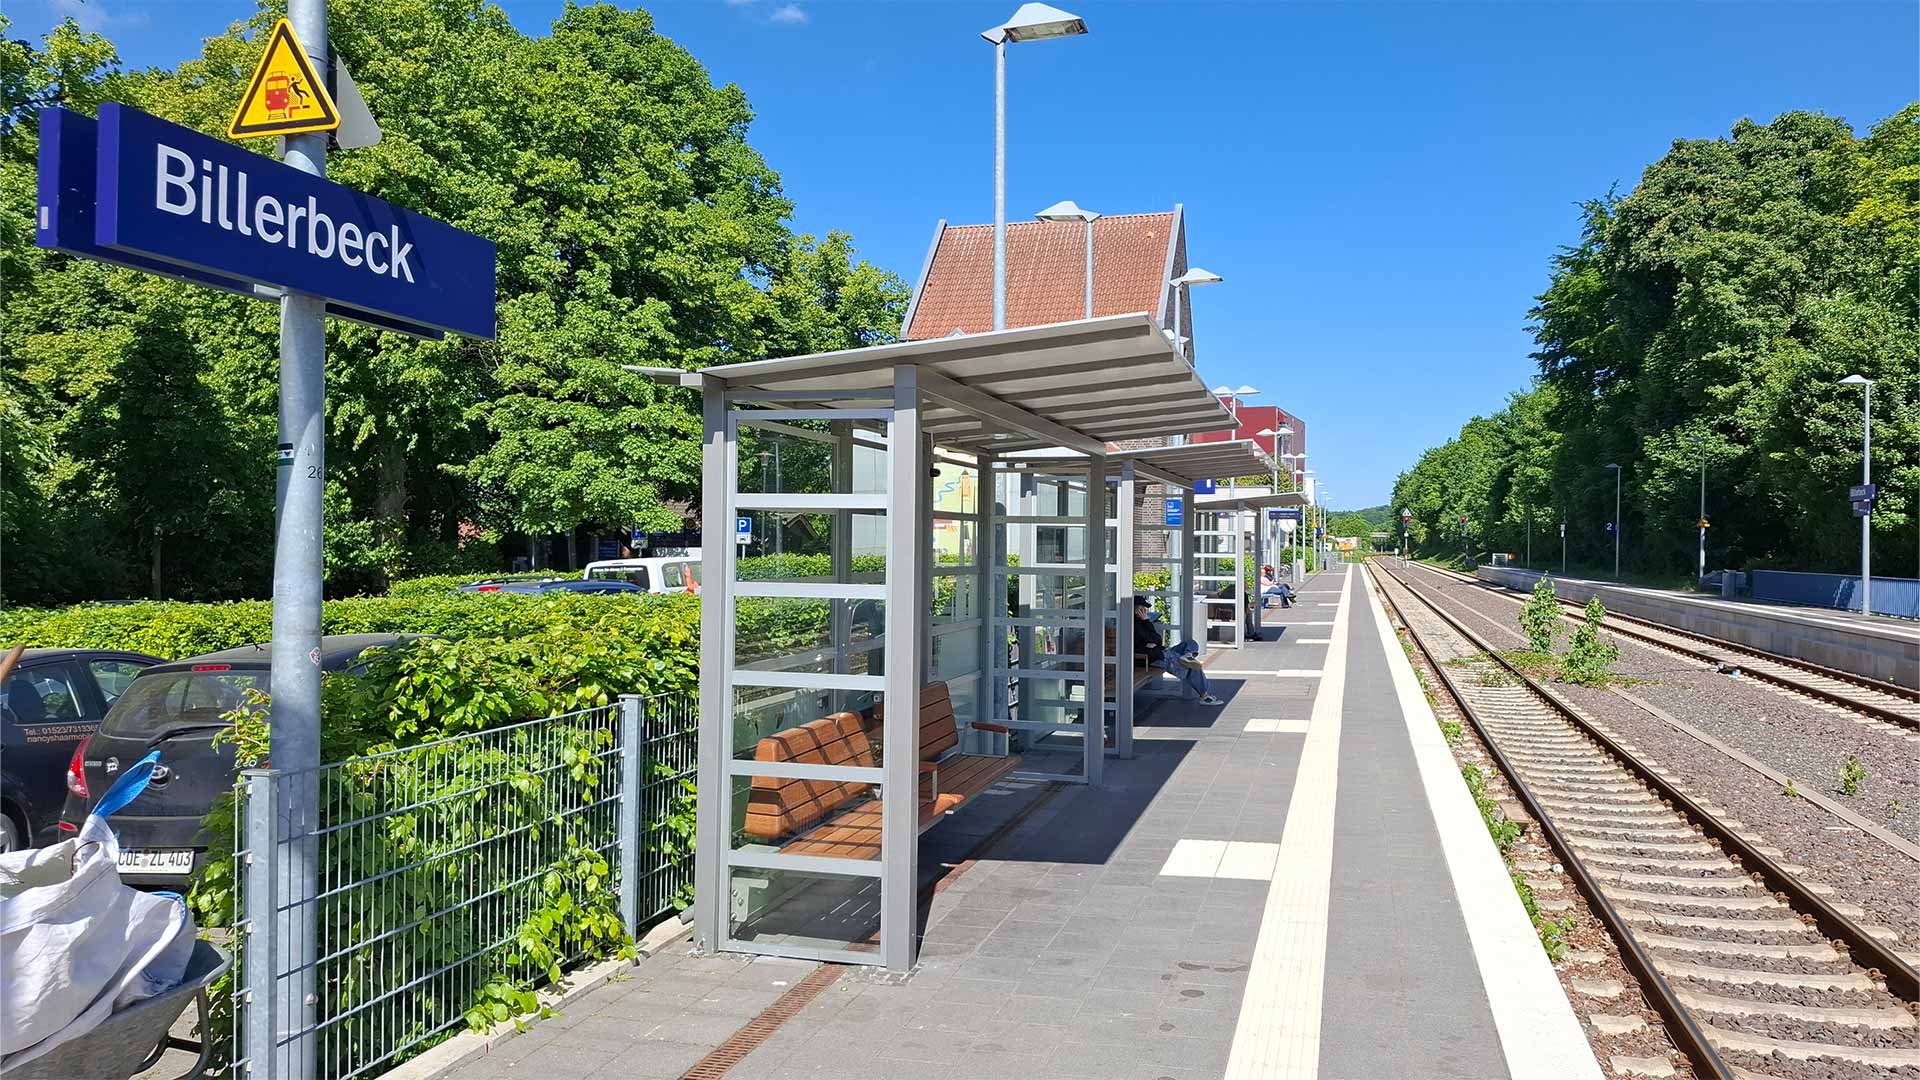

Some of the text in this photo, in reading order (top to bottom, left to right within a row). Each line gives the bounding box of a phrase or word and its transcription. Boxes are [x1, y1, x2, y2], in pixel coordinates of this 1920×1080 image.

[156, 143, 415, 283] Billerbeck
[738, 519, 748, 531] P
[1606, 522, 1613, 531] 2
[117, 850, 191, 867] COE ZL 403
